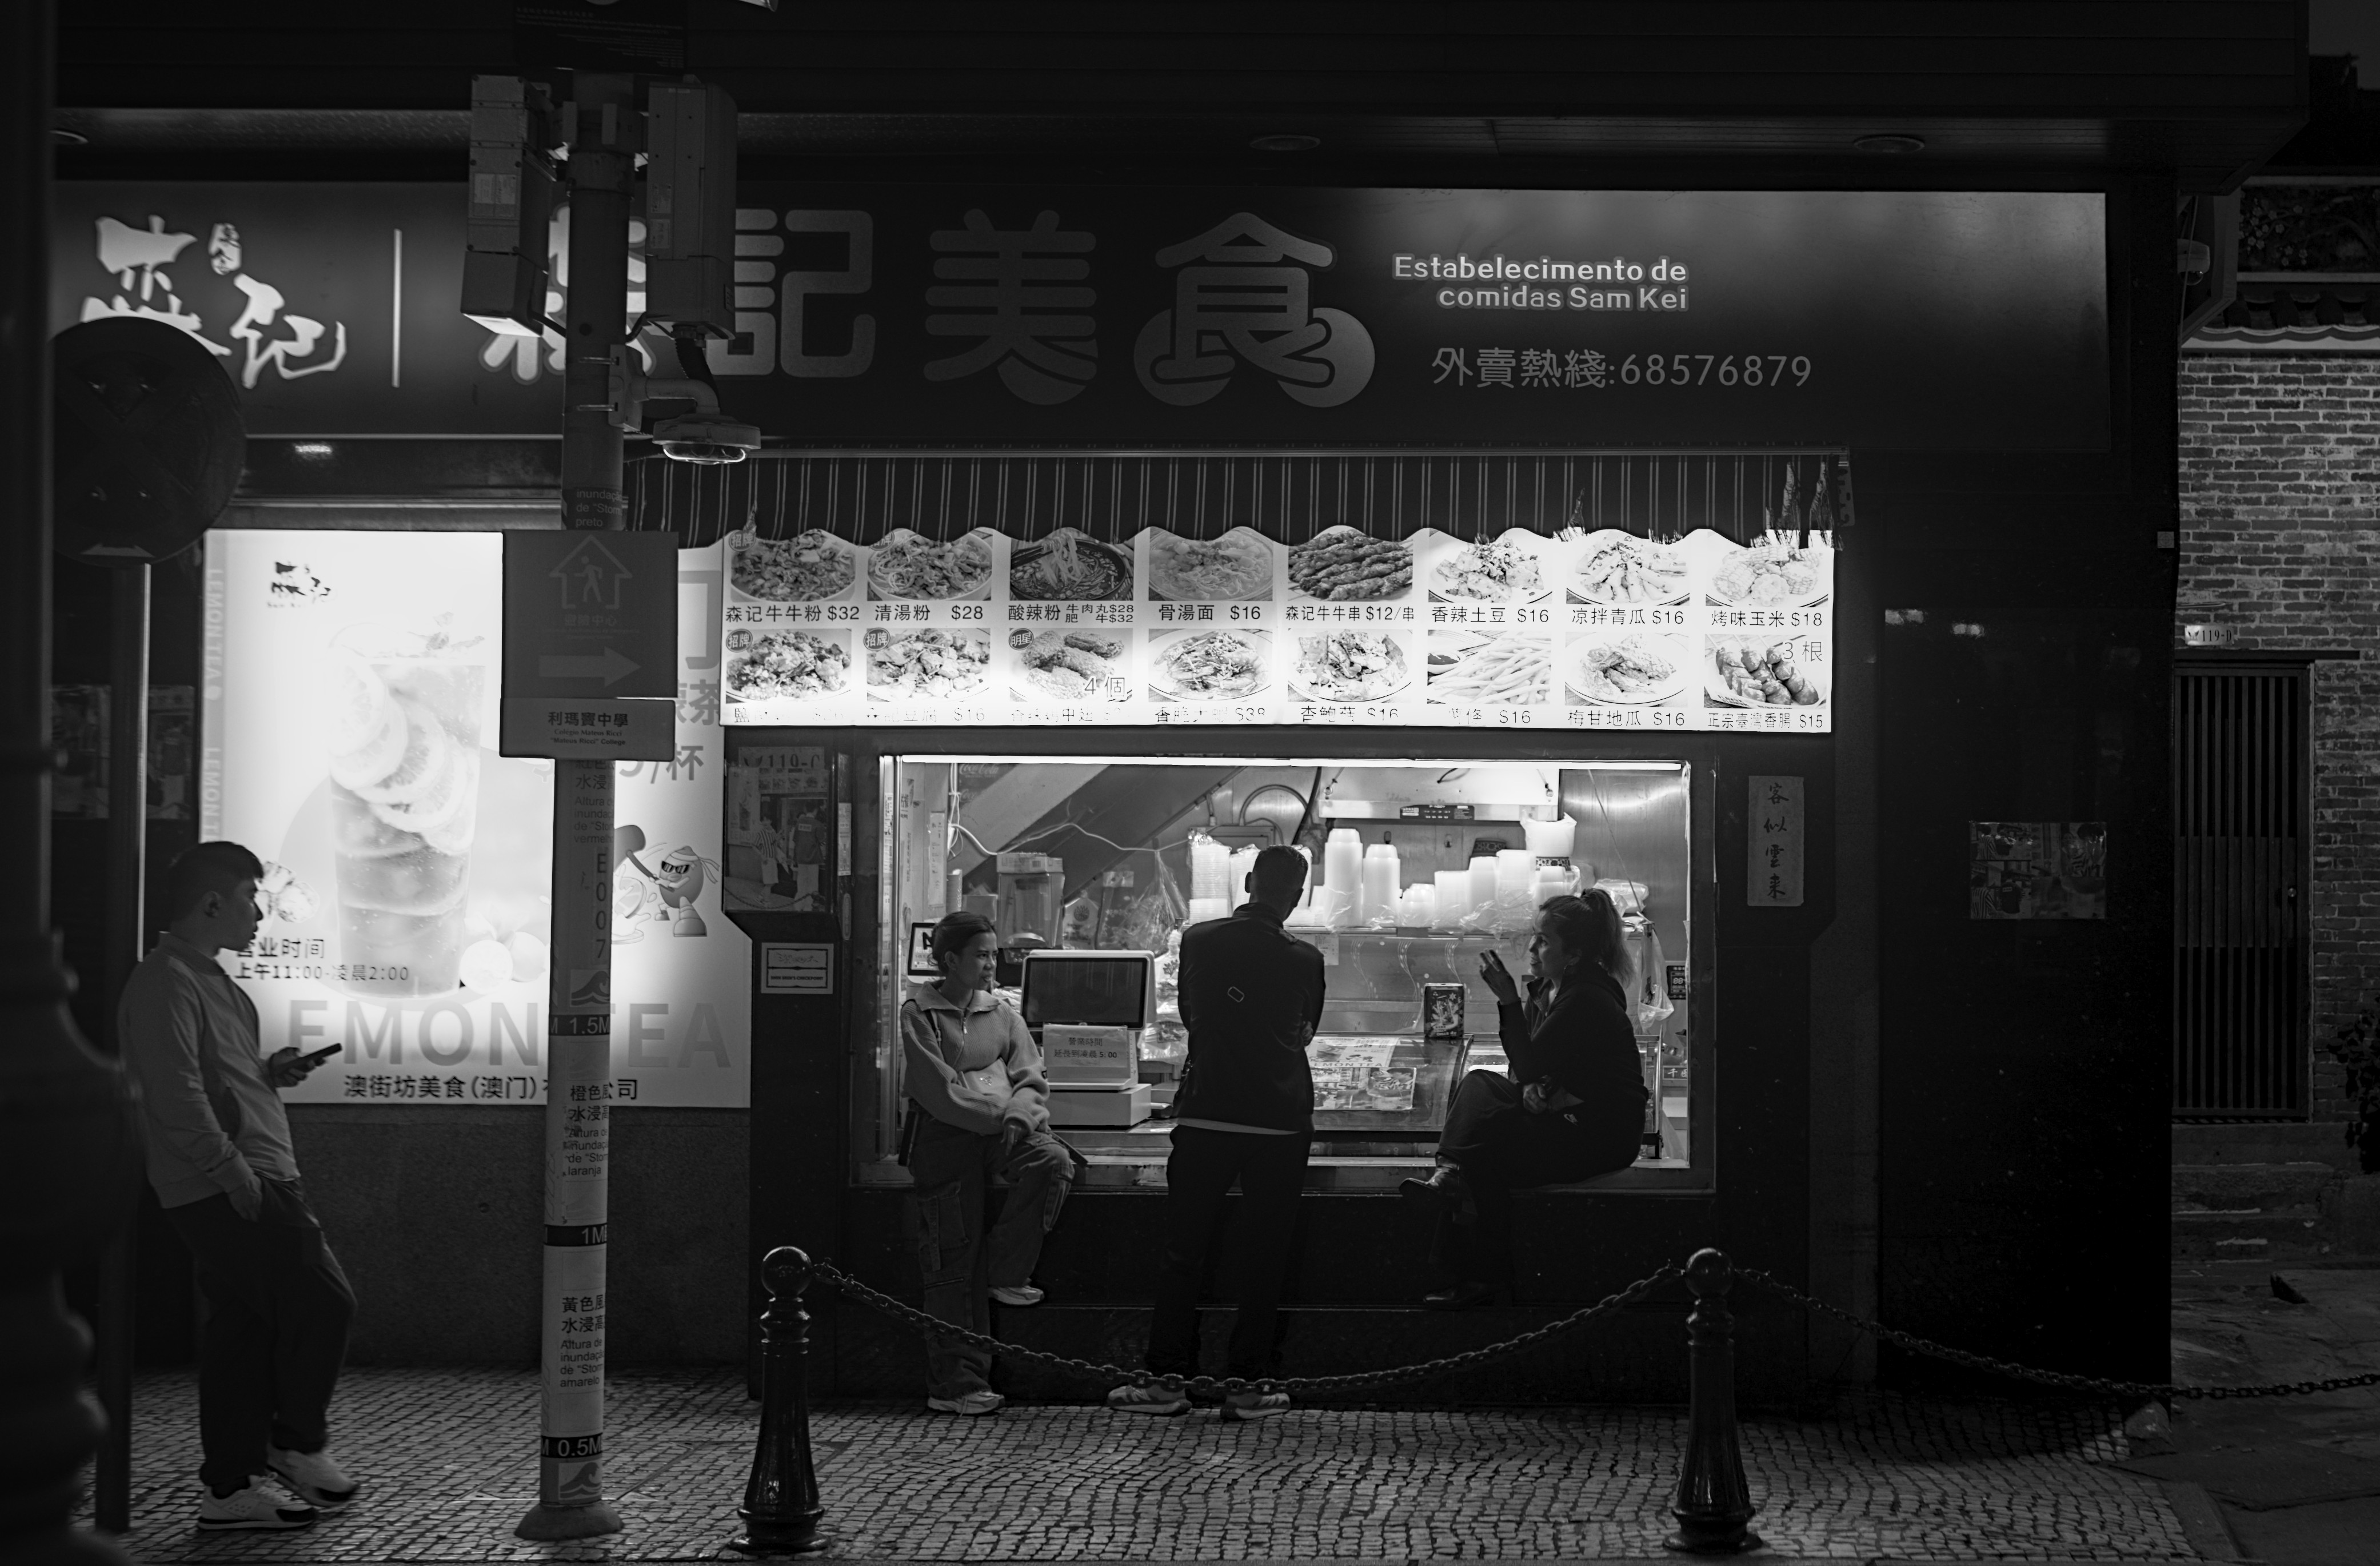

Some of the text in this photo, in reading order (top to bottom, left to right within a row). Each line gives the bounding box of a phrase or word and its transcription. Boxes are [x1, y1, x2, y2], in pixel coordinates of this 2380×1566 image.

[1395, 256, 1687, 281] Estabelecimento de
[1439, 286, 1687, 310] comidas Sam Kei
[576, 503, 589, 512] de
[576, 517, 603, 528] preto
[725, 605, 860, 623] 森记牛牛粉 $32
[874, 604, 983, 621] 清湯粉 $28
[1008, 604, 1061, 621] 酸辣粉
[1159, 604, 1260, 621] 骨湯面 $16
[1285, 605, 1414, 621] 森记牛牛串 $12/串
[1432, 607, 1549, 623] 香辣土豆 $16
[1652, 610, 1683, 625] $16
[1711, 610, 1823, 627] 烤味玉米 $18
[728, 633, 752, 649] 招牌
[865, 632, 889, 648] 招牌
[1011, 633, 1032, 647] 明星
[2202, 629, 2232, 641] 119-D
[1802, 640, 1823, 663] 根
[1499, 710, 1531, 724] $16
[1653, 712, 1686, 726] $16
[1799, 714, 1824, 728] $15
[575, 796, 605, 806] Altura
[574, 821, 588, 831] de
[568, 1016, 610, 1035] 1.5M
[568, 1154, 582, 1163] de
[568, 1165, 602, 1177] laranja
[560, 1340, 592, 1349] Altura
[560, 1365, 574, 1374] de
[560, 1376, 600, 1388] amarelo
[557, 1438, 601, 1457] 0.5M
